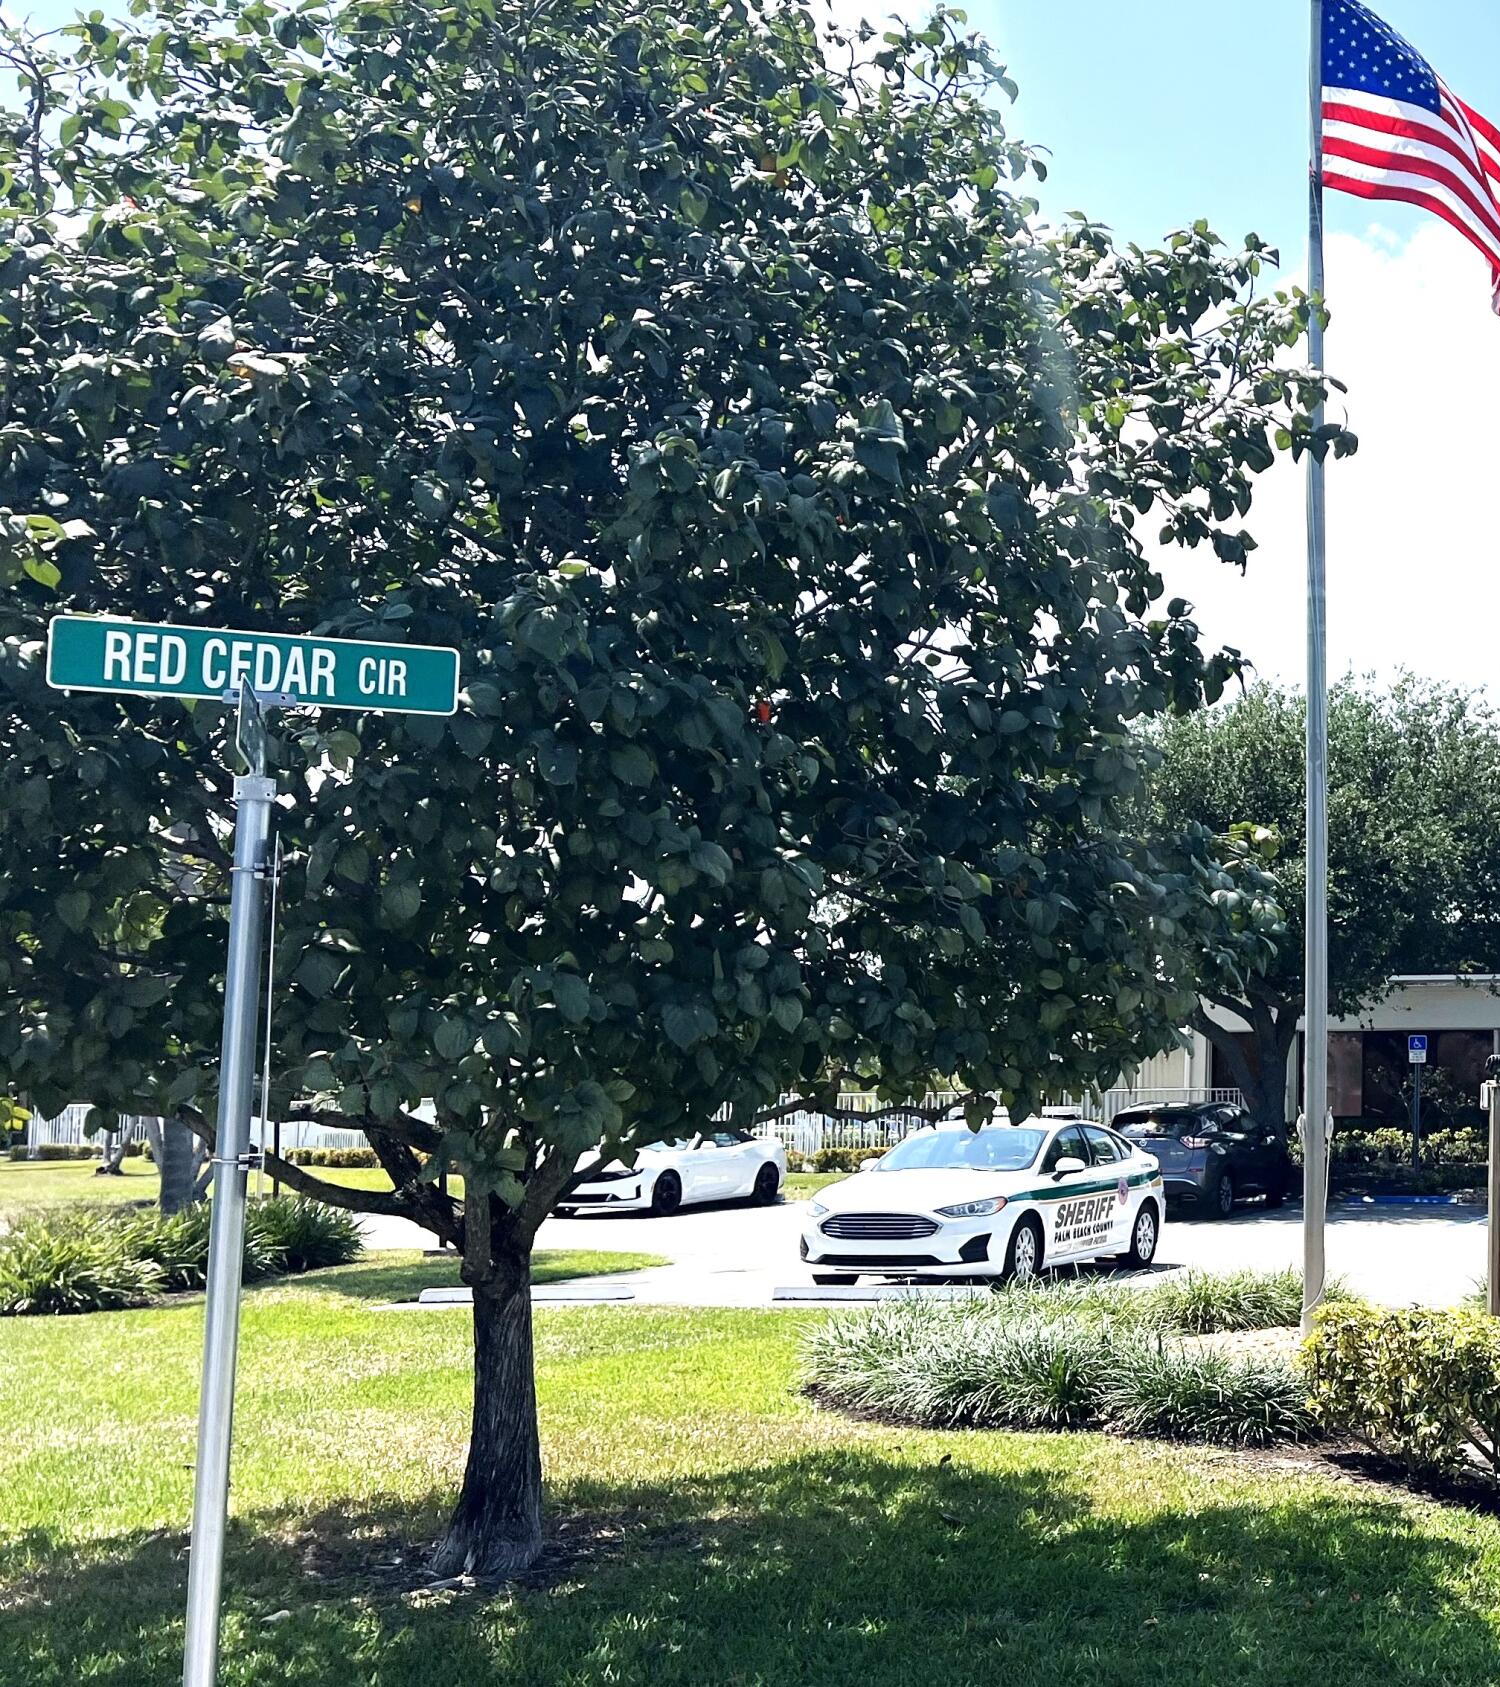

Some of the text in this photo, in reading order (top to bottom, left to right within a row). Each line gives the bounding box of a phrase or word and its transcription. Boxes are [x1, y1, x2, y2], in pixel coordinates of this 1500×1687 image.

[103, 630, 407, 697] RED CEDAR CIR
[1054, 1195, 1116, 1229] SHERIFF
[1054, 1228, 1071, 1244] PALM
[1073, 1225, 1092, 1239] BEACH
[1092, 1220, 1114, 1234] COUNTY
